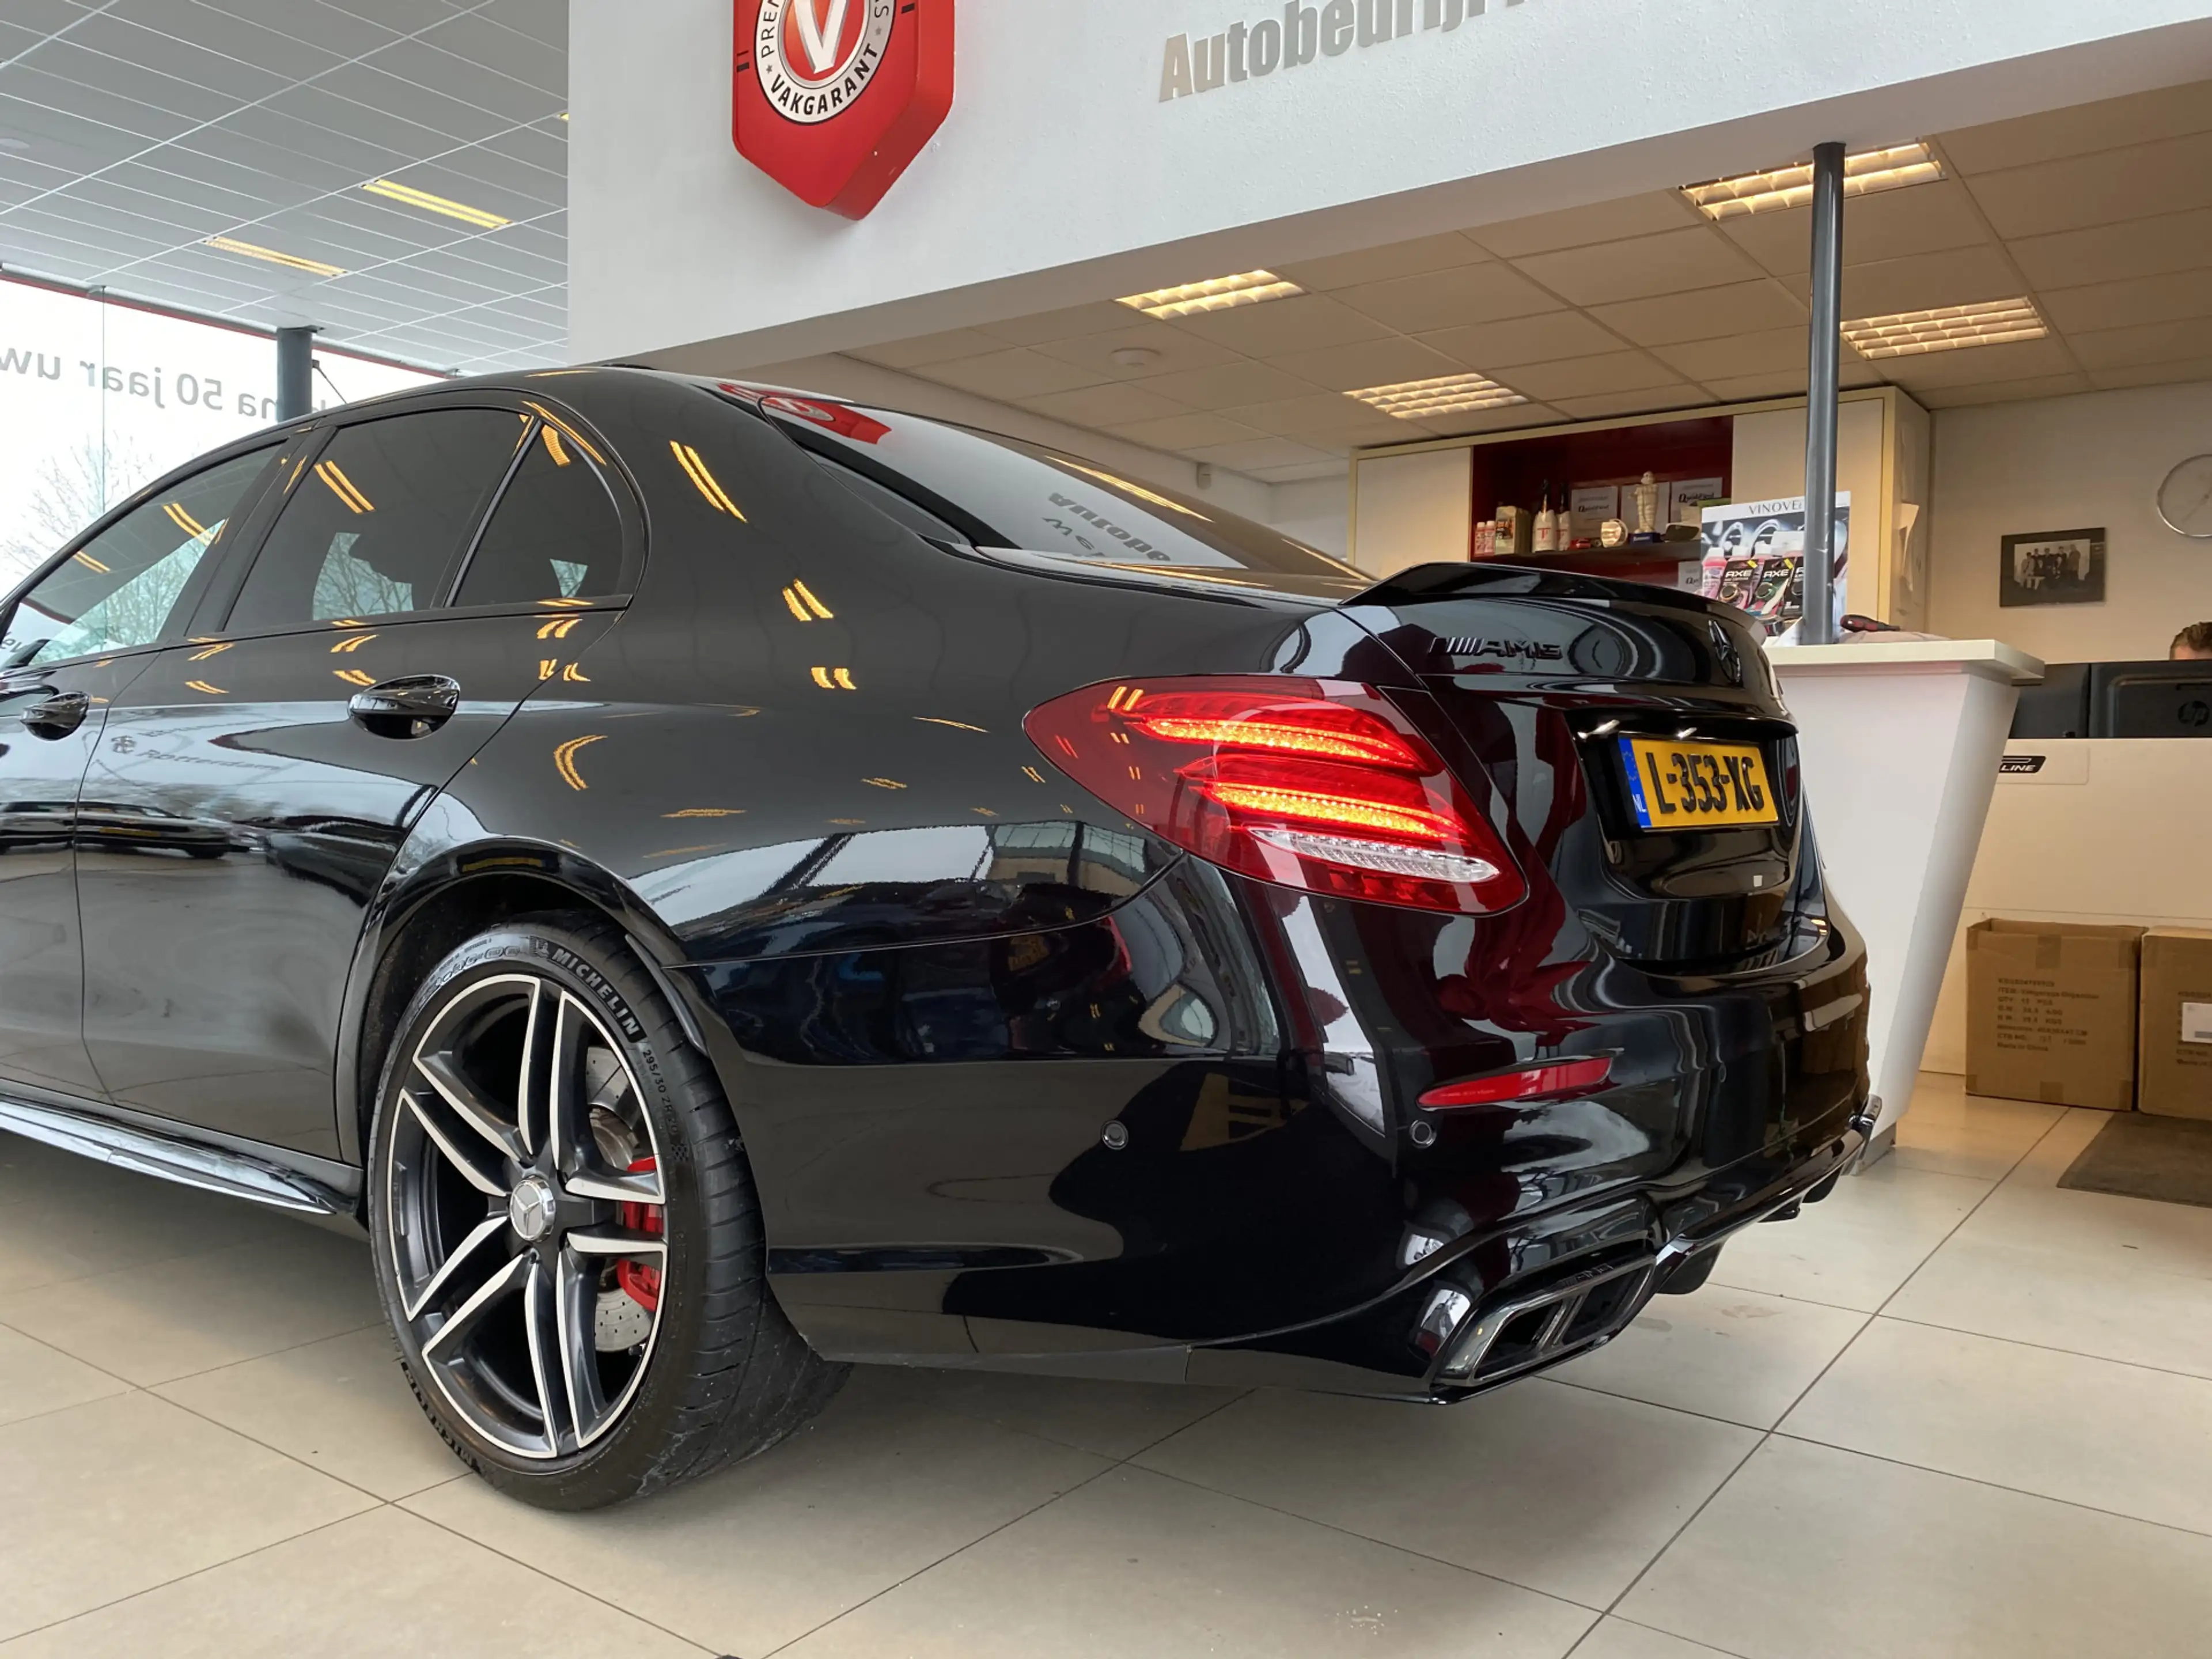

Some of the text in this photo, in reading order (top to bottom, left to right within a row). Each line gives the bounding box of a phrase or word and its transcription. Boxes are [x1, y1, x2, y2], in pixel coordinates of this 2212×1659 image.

[771, 43, 878, 115] VAKGARANT
[1725, 569, 1752, 578] AXE
[1763, 569, 1790, 578] AXE
[1633, 794, 1647, 813] NL
[1646, 752, 1765, 815] L-353-XG
[552, 948, 639, 1035] MICHELIN
[643, 1049, 666, 1094] 295/30
